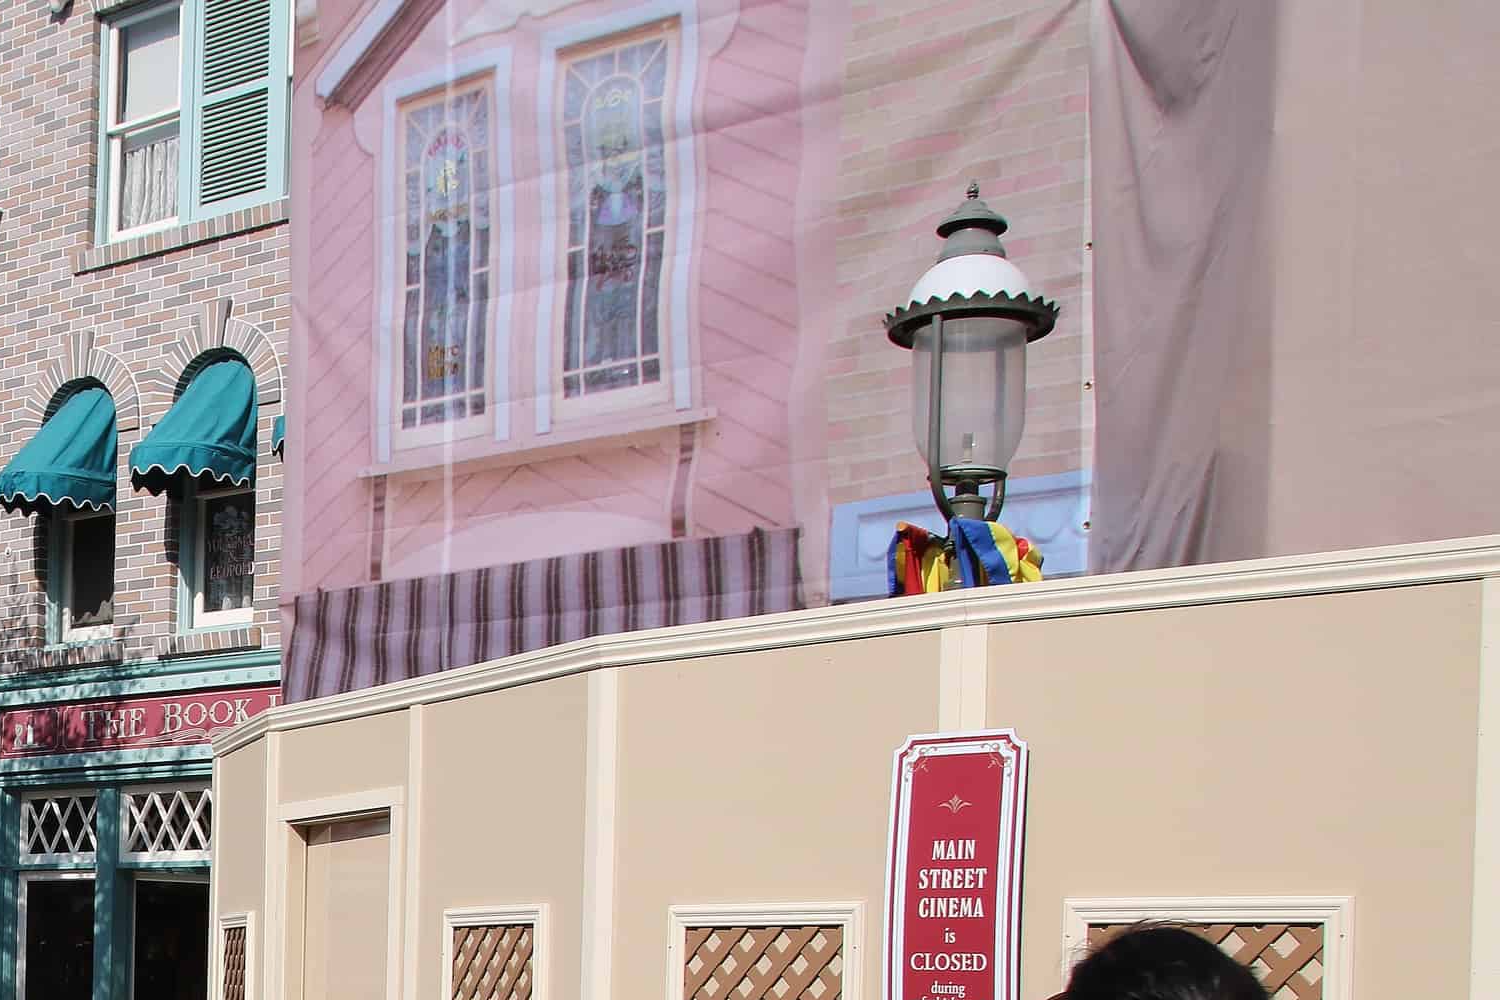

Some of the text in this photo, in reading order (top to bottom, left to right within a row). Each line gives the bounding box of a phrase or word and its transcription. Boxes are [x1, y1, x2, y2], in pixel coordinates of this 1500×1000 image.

[81, 707, 147, 743] THE
[161, 698, 253, 733] BOOK
[931, 839, 976, 861] MAIN
[918, 867, 988, 890] STREET
[918, 897, 984, 918] CINEMA
[944, 927, 956, 944] is
[910, 953, 987, 972] CLOSED
[930, 981, 966, 998] during
